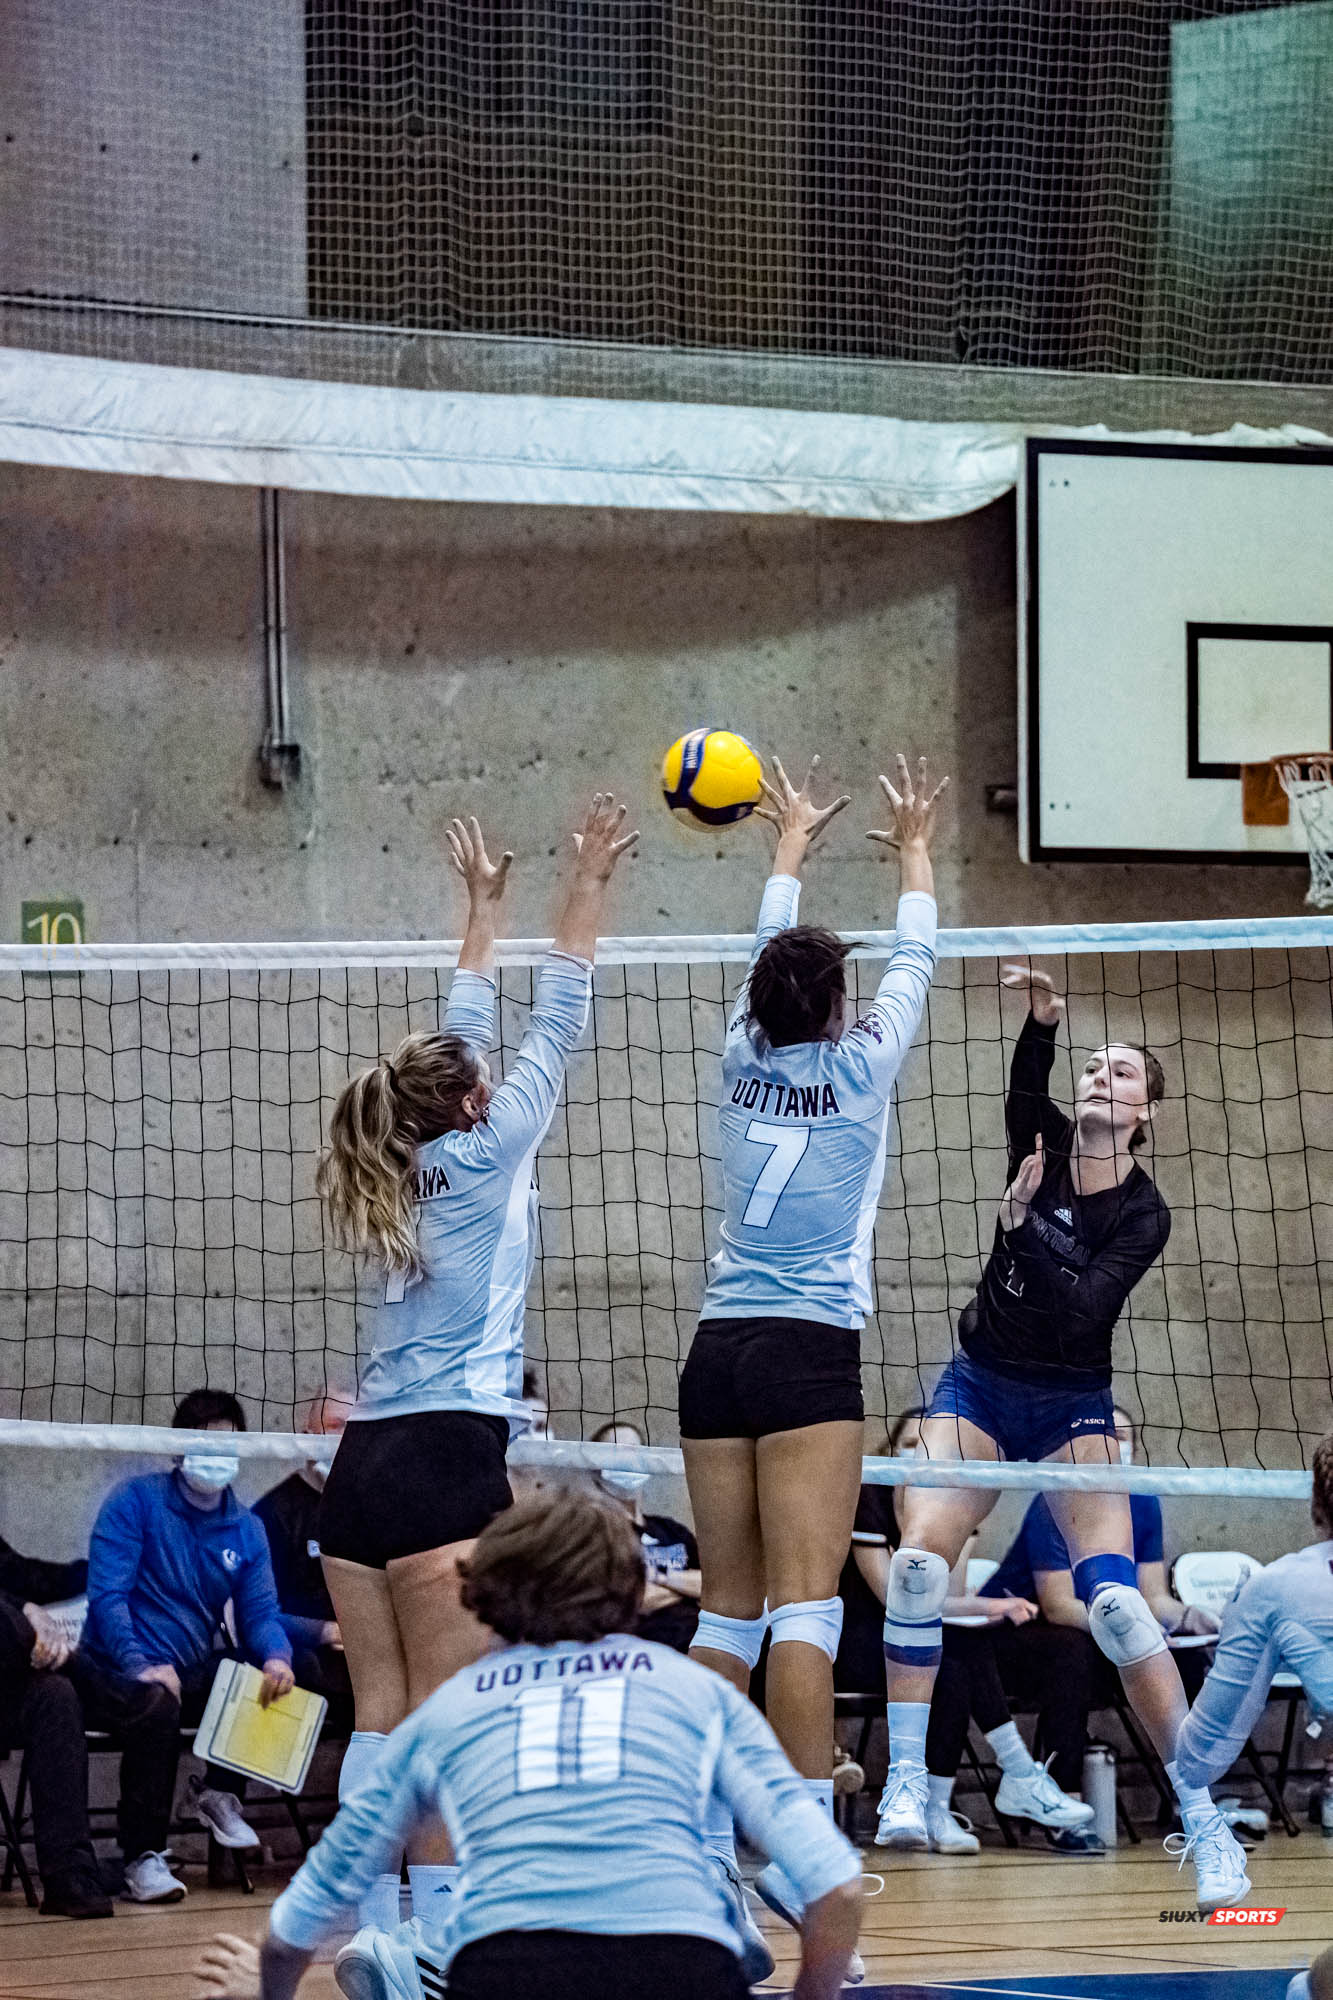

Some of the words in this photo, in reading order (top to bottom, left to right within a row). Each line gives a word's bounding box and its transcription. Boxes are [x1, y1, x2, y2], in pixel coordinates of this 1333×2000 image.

[27, 911, 82, 951] 10
[731, 1077, 841, 1118] UOTTAWA
[741, 1119, 811, 1229] 7
[476, 1652, 654, 1693] UOTTAWA
[512, 1675, 630, 1795] 11
